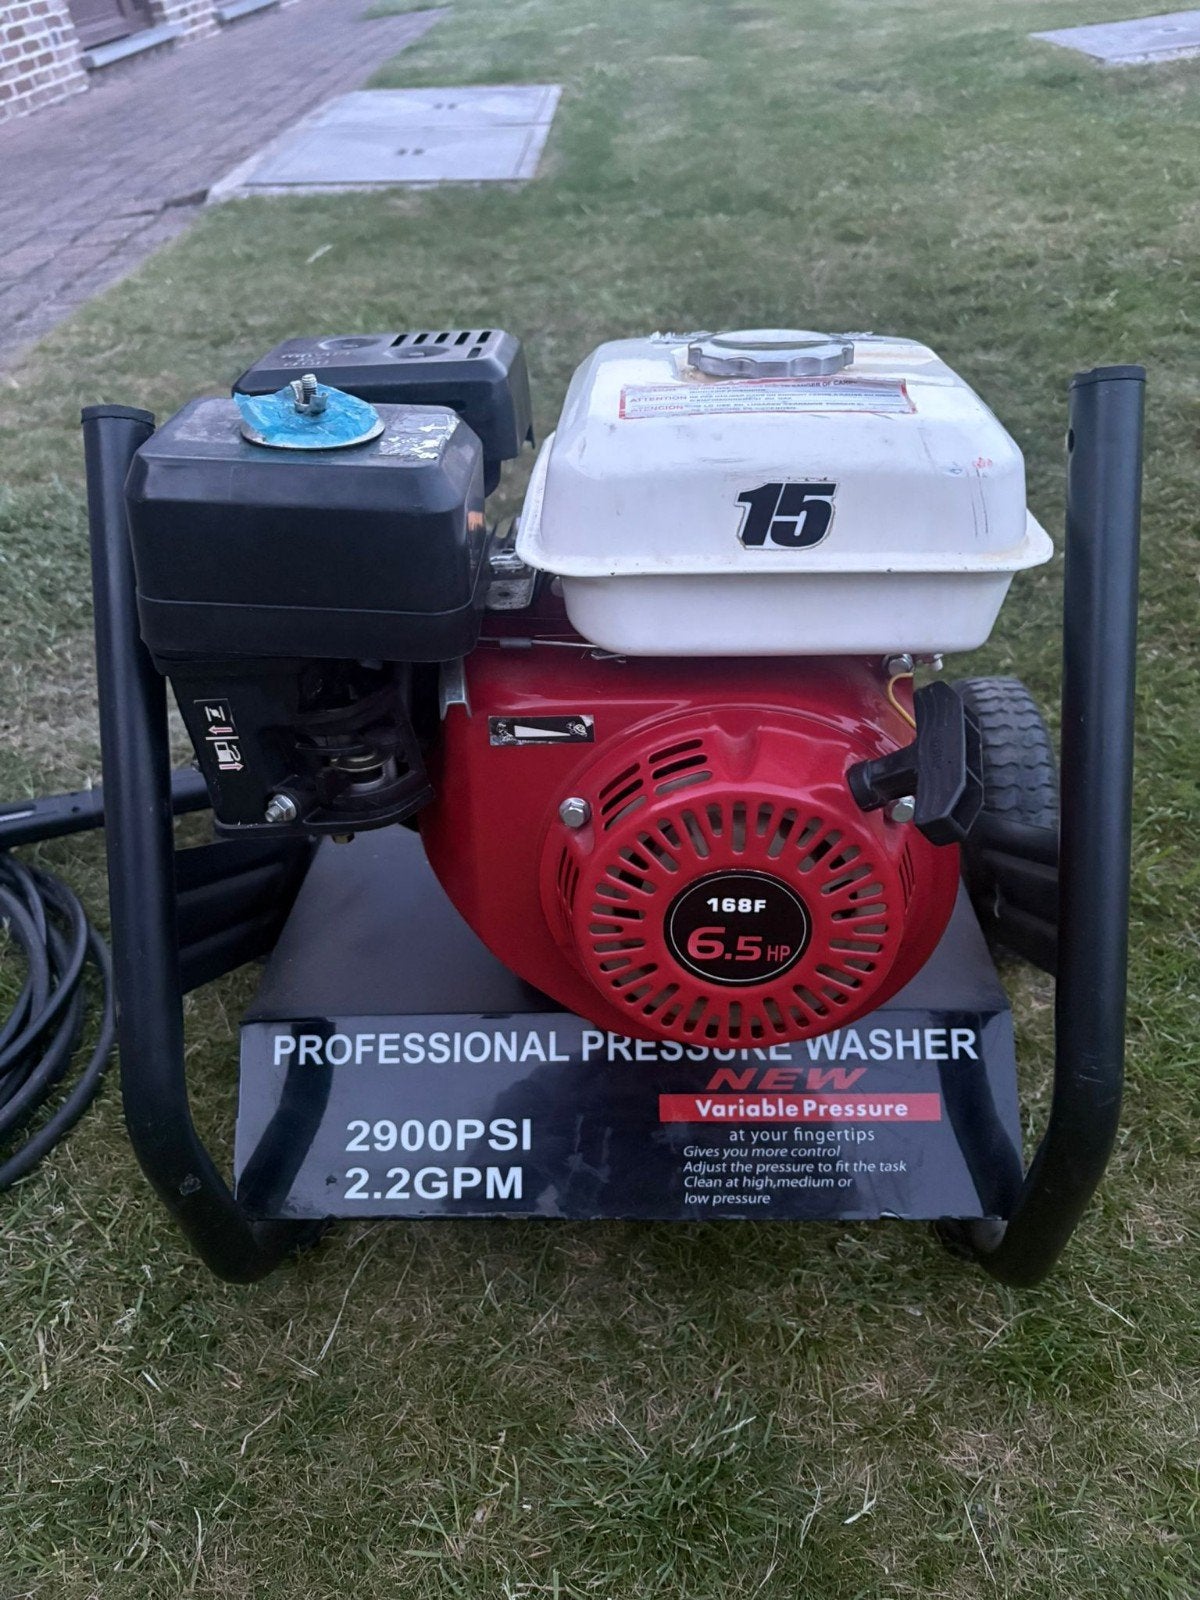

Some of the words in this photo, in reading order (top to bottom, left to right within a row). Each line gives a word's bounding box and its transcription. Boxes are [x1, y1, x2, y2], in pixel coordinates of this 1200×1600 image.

[737, 482, 836, 549] 15
[706, 897, 767, 913] 168F
[687, 926, 763, 961] 6.5
[767, 945, 791, 962] HP
[273, 1031, 570, 1066] PROFESSIONAL
[805, 1028, 979, 1061] WASHER
[705, 1068, 868, 1090] NEW
[695, 1098, 799, 1117] Variable
[803, 1099, 908, 1117] Pressure
[344, 1118, 532, 1152] 2900PSI
[729, 1130, 745, 1142] at
[751, 1130, 788, 1145] your
[794, 1127, 876, 1145] fingertips
[683, 1146, 720, 1158] Gives
[722, 1148, 748, 1160] you
[751, 1148, 788, 1158] more
[790, 1145, 841, 1158] control
[682, 1161, 726, 1174] Adjust
[731, 1161, 752, 1173] the
[755, 1162, 814, 1175] pressure
[818, 1162, 832, 1173] to
[835, 1160, 851, 1173] fit
[853, 1160, 876, 1173] the
[879, 1160, 907, 1173] task
[343, 1166, 524, 1200] 2.2GPM
[684, 1176, 722, 1188] Clean
[725, 1177, 738, 1188] at
[742, 1176, 834, 1190] high,medium
[837, 1178, 853, 1188] or
[684, 1192, 709, 1204] low
[712, 1194, 772, 1206] pressure
